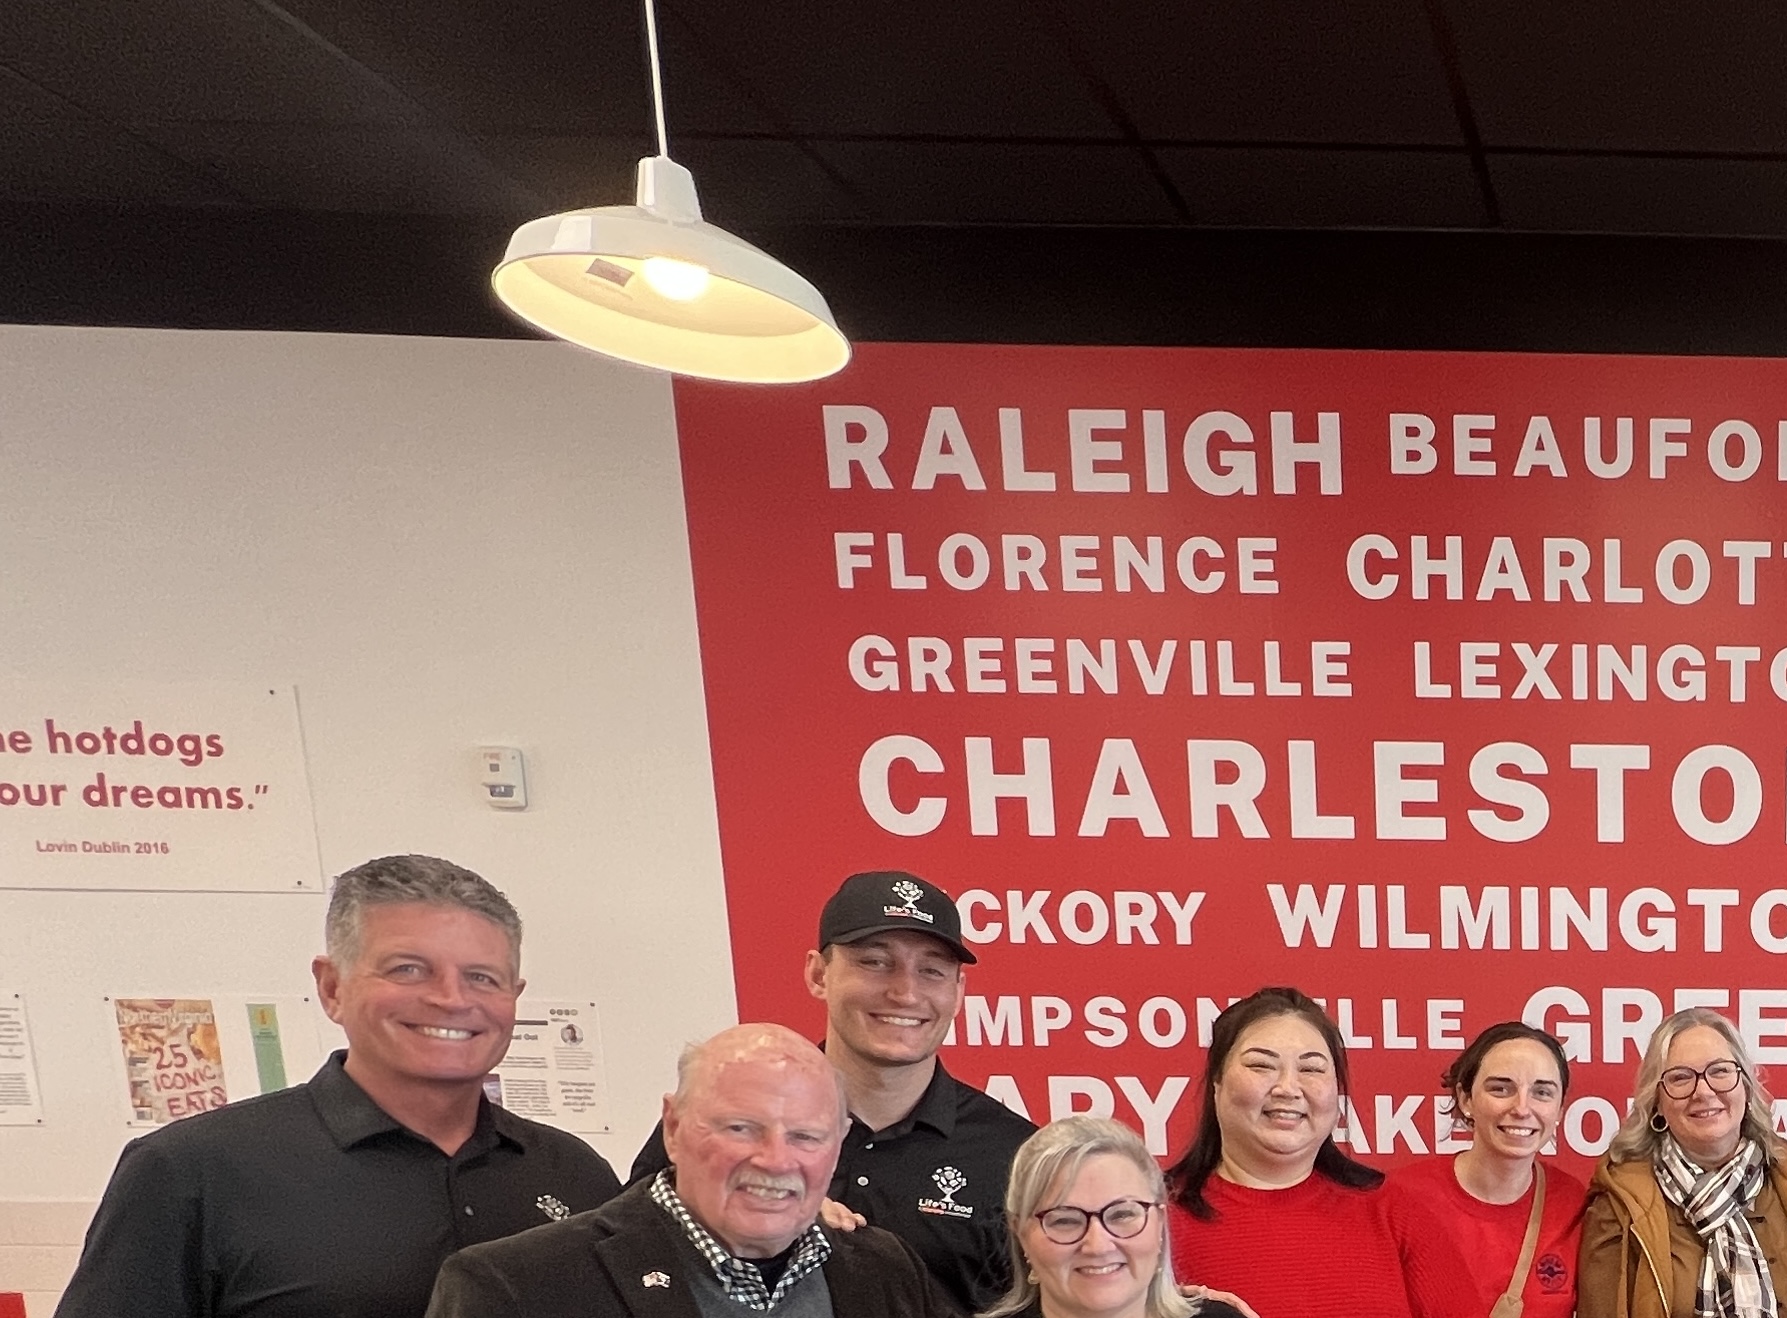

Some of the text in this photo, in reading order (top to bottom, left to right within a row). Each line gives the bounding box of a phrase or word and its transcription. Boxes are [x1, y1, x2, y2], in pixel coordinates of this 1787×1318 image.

[822, 404, 1342, 496] RALEIGH
[833, 531, 1280, 595] FLORENCE
[847, 634, 1353, 698] GREENVILLE
[0, 718, 224, 767] e hotdogs
[36, 840, 170, 855] Lovin Dublin 2016
[955, 888, 1206, 945] CKORY
[154, 1044, 188, 1070] 25
[168, 1086, 228, 1117] EATS
[1332, 1095, 1474, 1155] AKE
